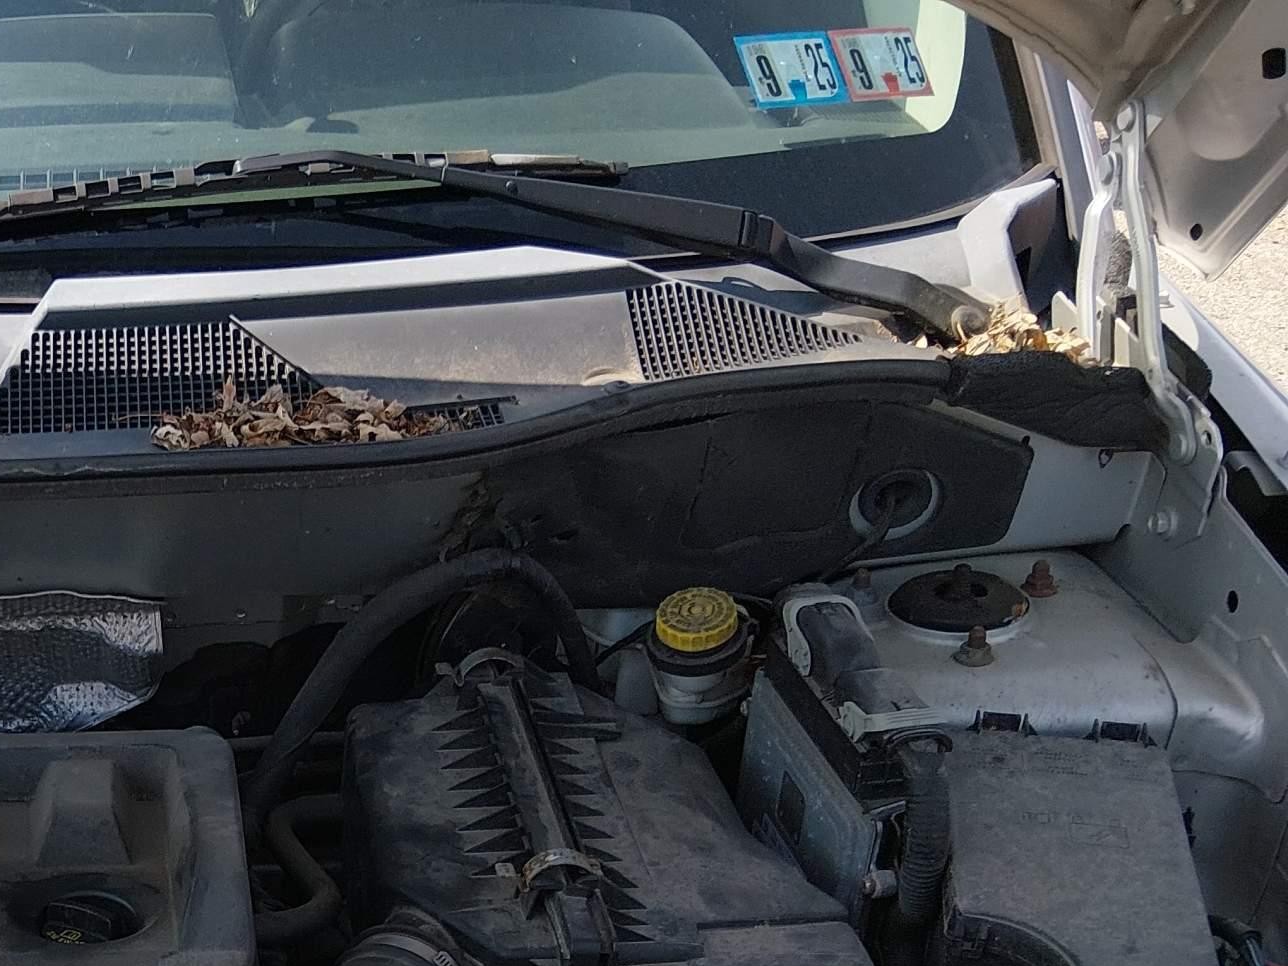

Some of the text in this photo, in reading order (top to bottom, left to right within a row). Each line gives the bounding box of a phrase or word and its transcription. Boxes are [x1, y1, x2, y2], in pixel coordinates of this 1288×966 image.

[756, 55, 782, 97] 9
[804, 43, 838, 91] 25
[850, 48, 874, 90] 9
[894, 36, 925, 84] 25
